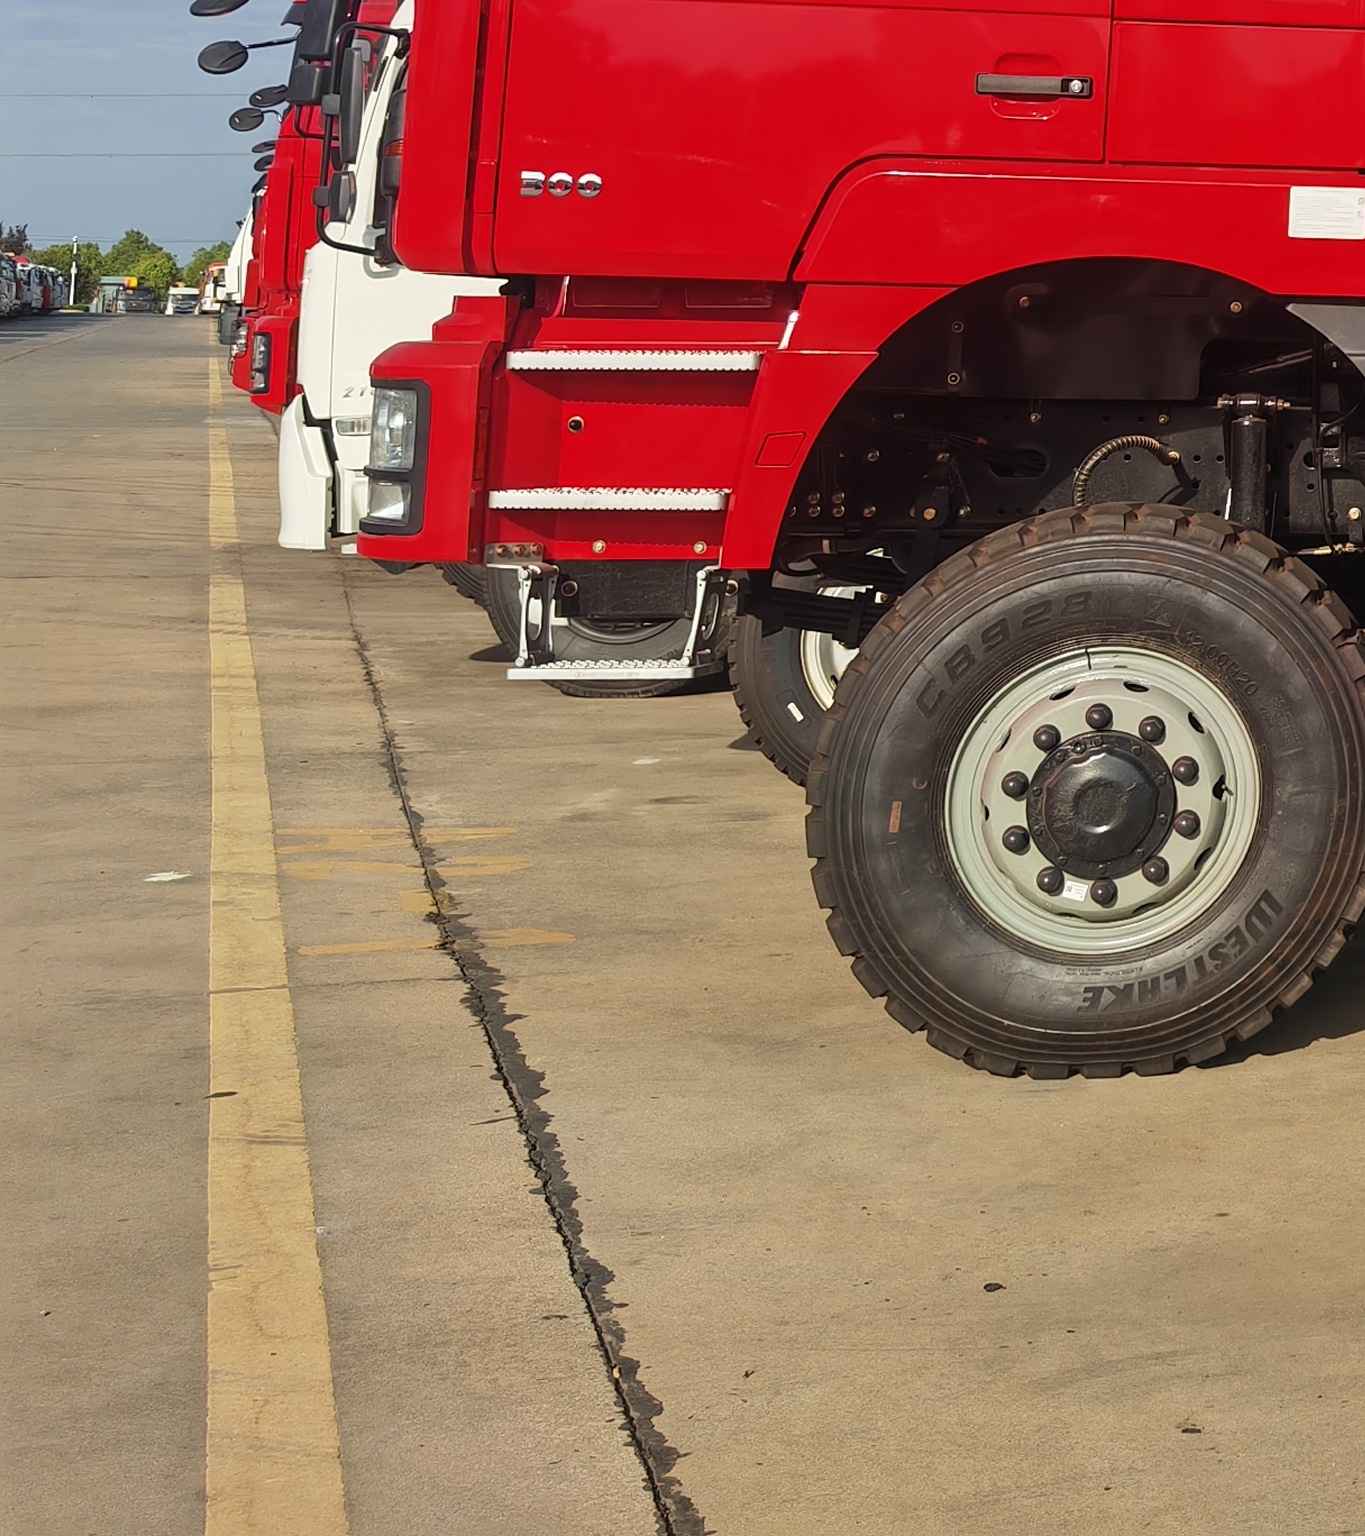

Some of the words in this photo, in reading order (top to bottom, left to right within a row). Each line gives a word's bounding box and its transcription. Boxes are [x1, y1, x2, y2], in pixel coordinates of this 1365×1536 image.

[520, 170, 602, 198] 300
[915, 590, 1093, 719] CB928
[1077, 889, 1283, 1013] WESTLAKE
